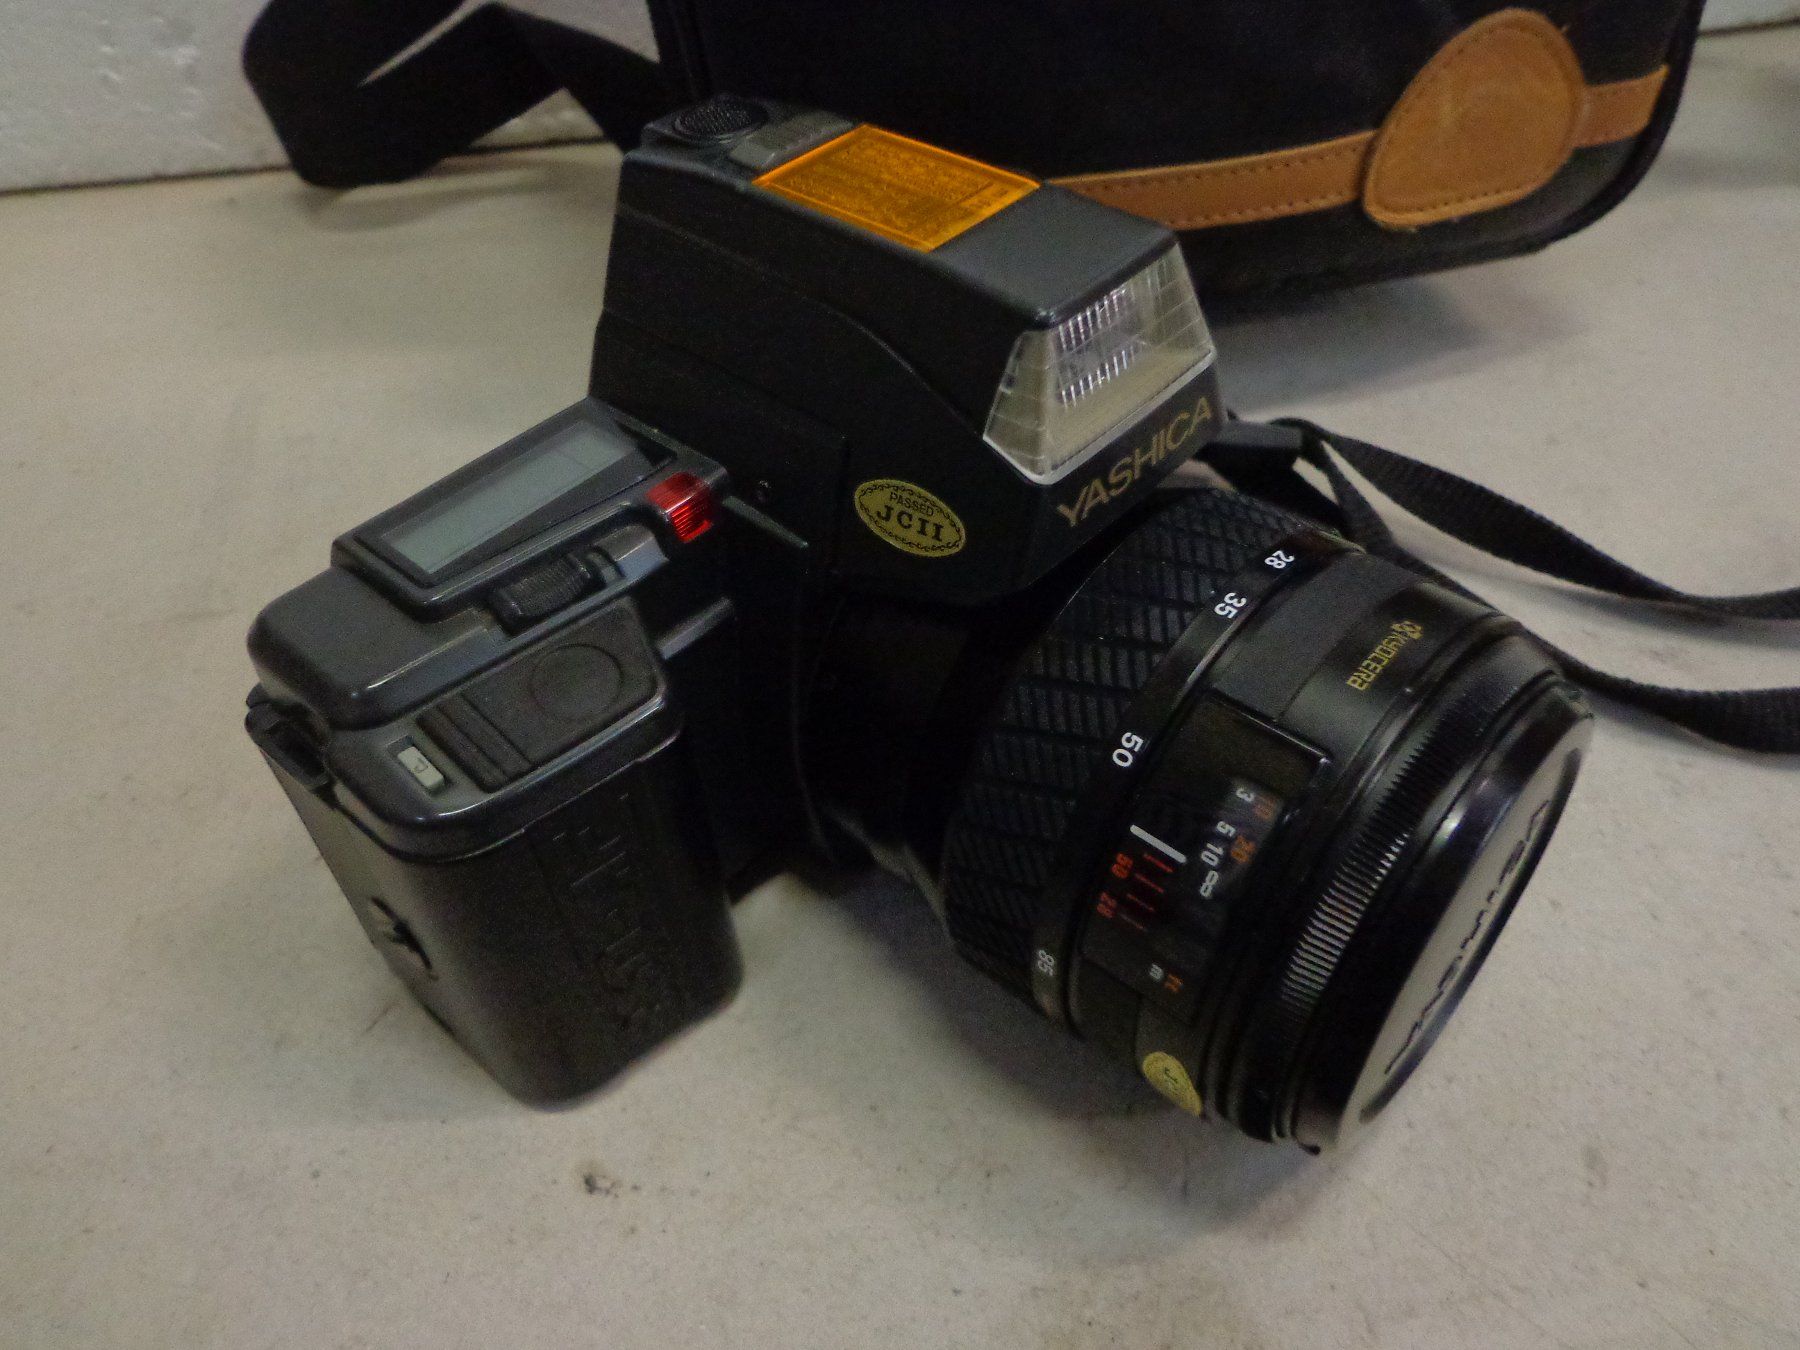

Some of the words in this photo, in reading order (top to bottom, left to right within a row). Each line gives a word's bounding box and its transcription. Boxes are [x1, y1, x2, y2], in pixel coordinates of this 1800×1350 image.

[1056, 396, 1212, 527] YASHICA
[890, 492, 934, 517] PASSED
[877, 504, 944, 542] JCII
[1264, 550, 1295, 570] 28
[1214, 592, 1247, 619] 35
[1346, 630, 1407, 691] KYOCERA
[1112, 731, 1145, 768] 50
[1235, 788, 1256, 803] 3
[1216, 820, 1237, 838] 5
[1200, 842, 1225, 868] 10
[1037, 948, 1055, 977] 85
